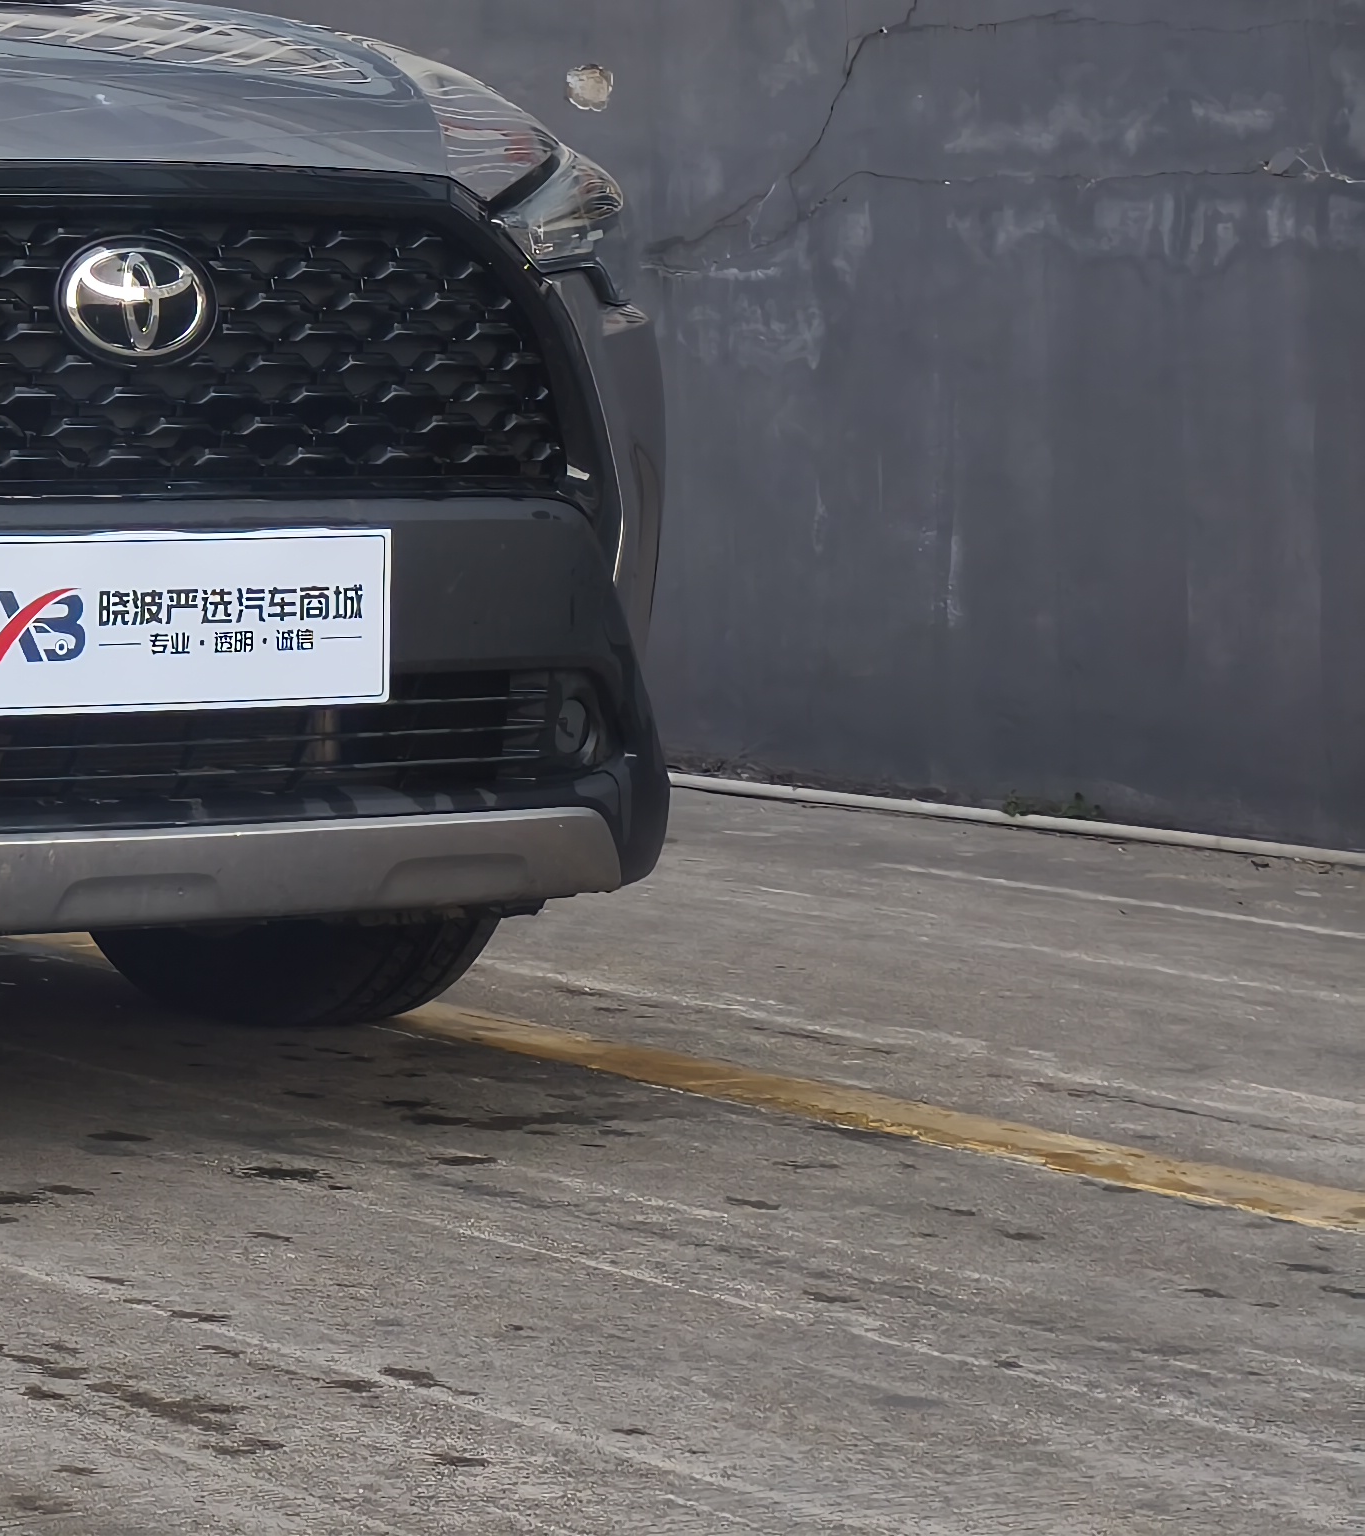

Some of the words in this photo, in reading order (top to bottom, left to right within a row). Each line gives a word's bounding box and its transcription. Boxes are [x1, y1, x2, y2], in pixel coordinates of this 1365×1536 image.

[98, 584, 364, 626] 晓波严选汽车商城
